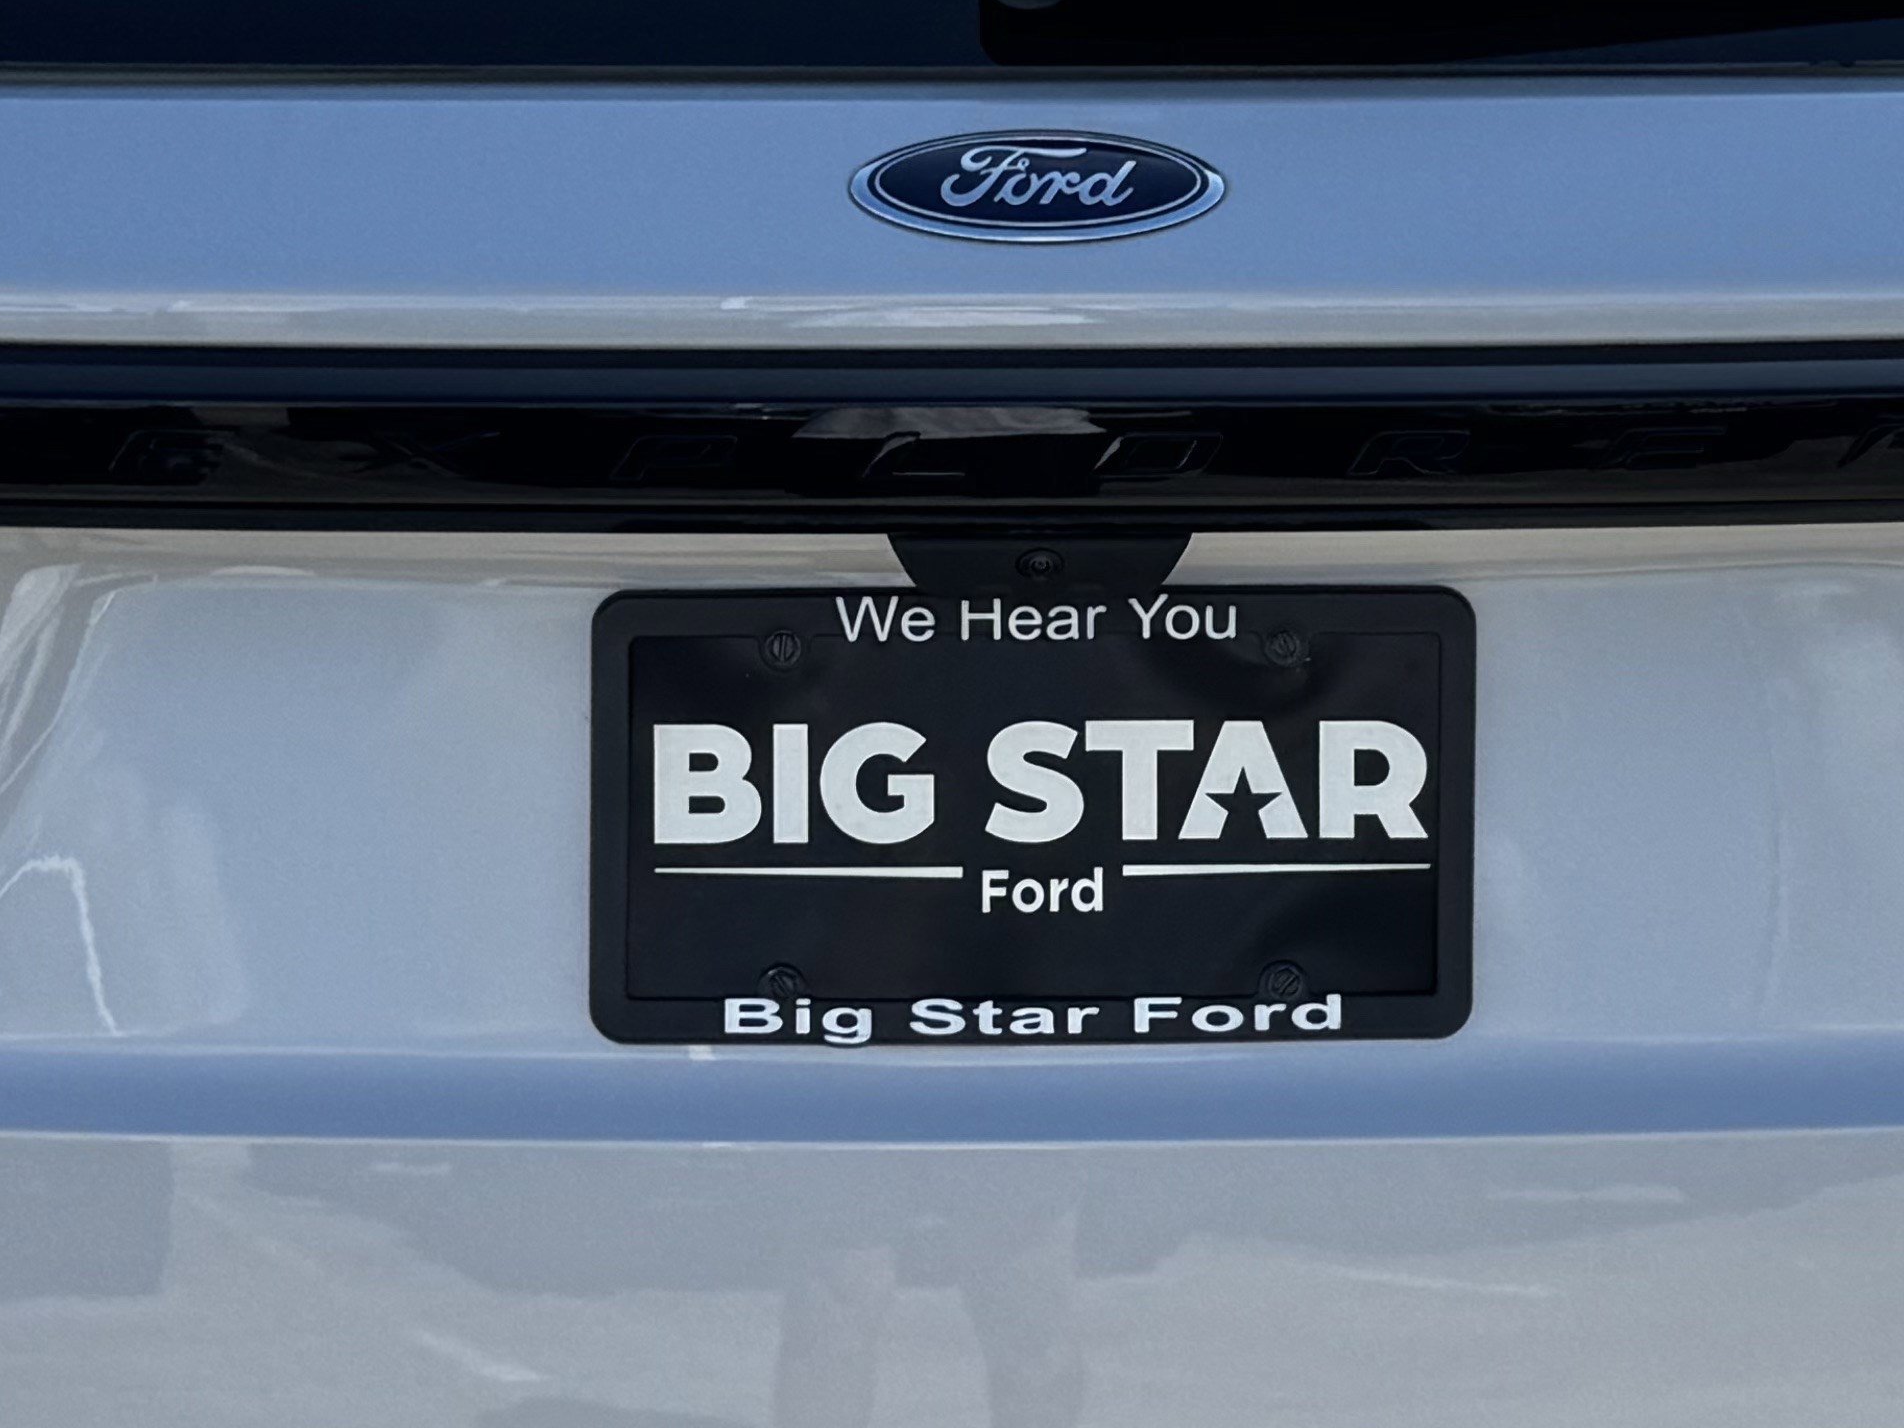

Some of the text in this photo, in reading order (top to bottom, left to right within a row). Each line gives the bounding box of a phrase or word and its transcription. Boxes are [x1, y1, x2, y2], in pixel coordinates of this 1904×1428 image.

[939, 144, 1138, 207] Ford
[836, 594, 1238, 642] We Hear You
[653, 719, 1429, 845] BIG STAR
[981, 866, 1104, 914] Ford
[722, 993, 1343, 1044] Big Star Ford
